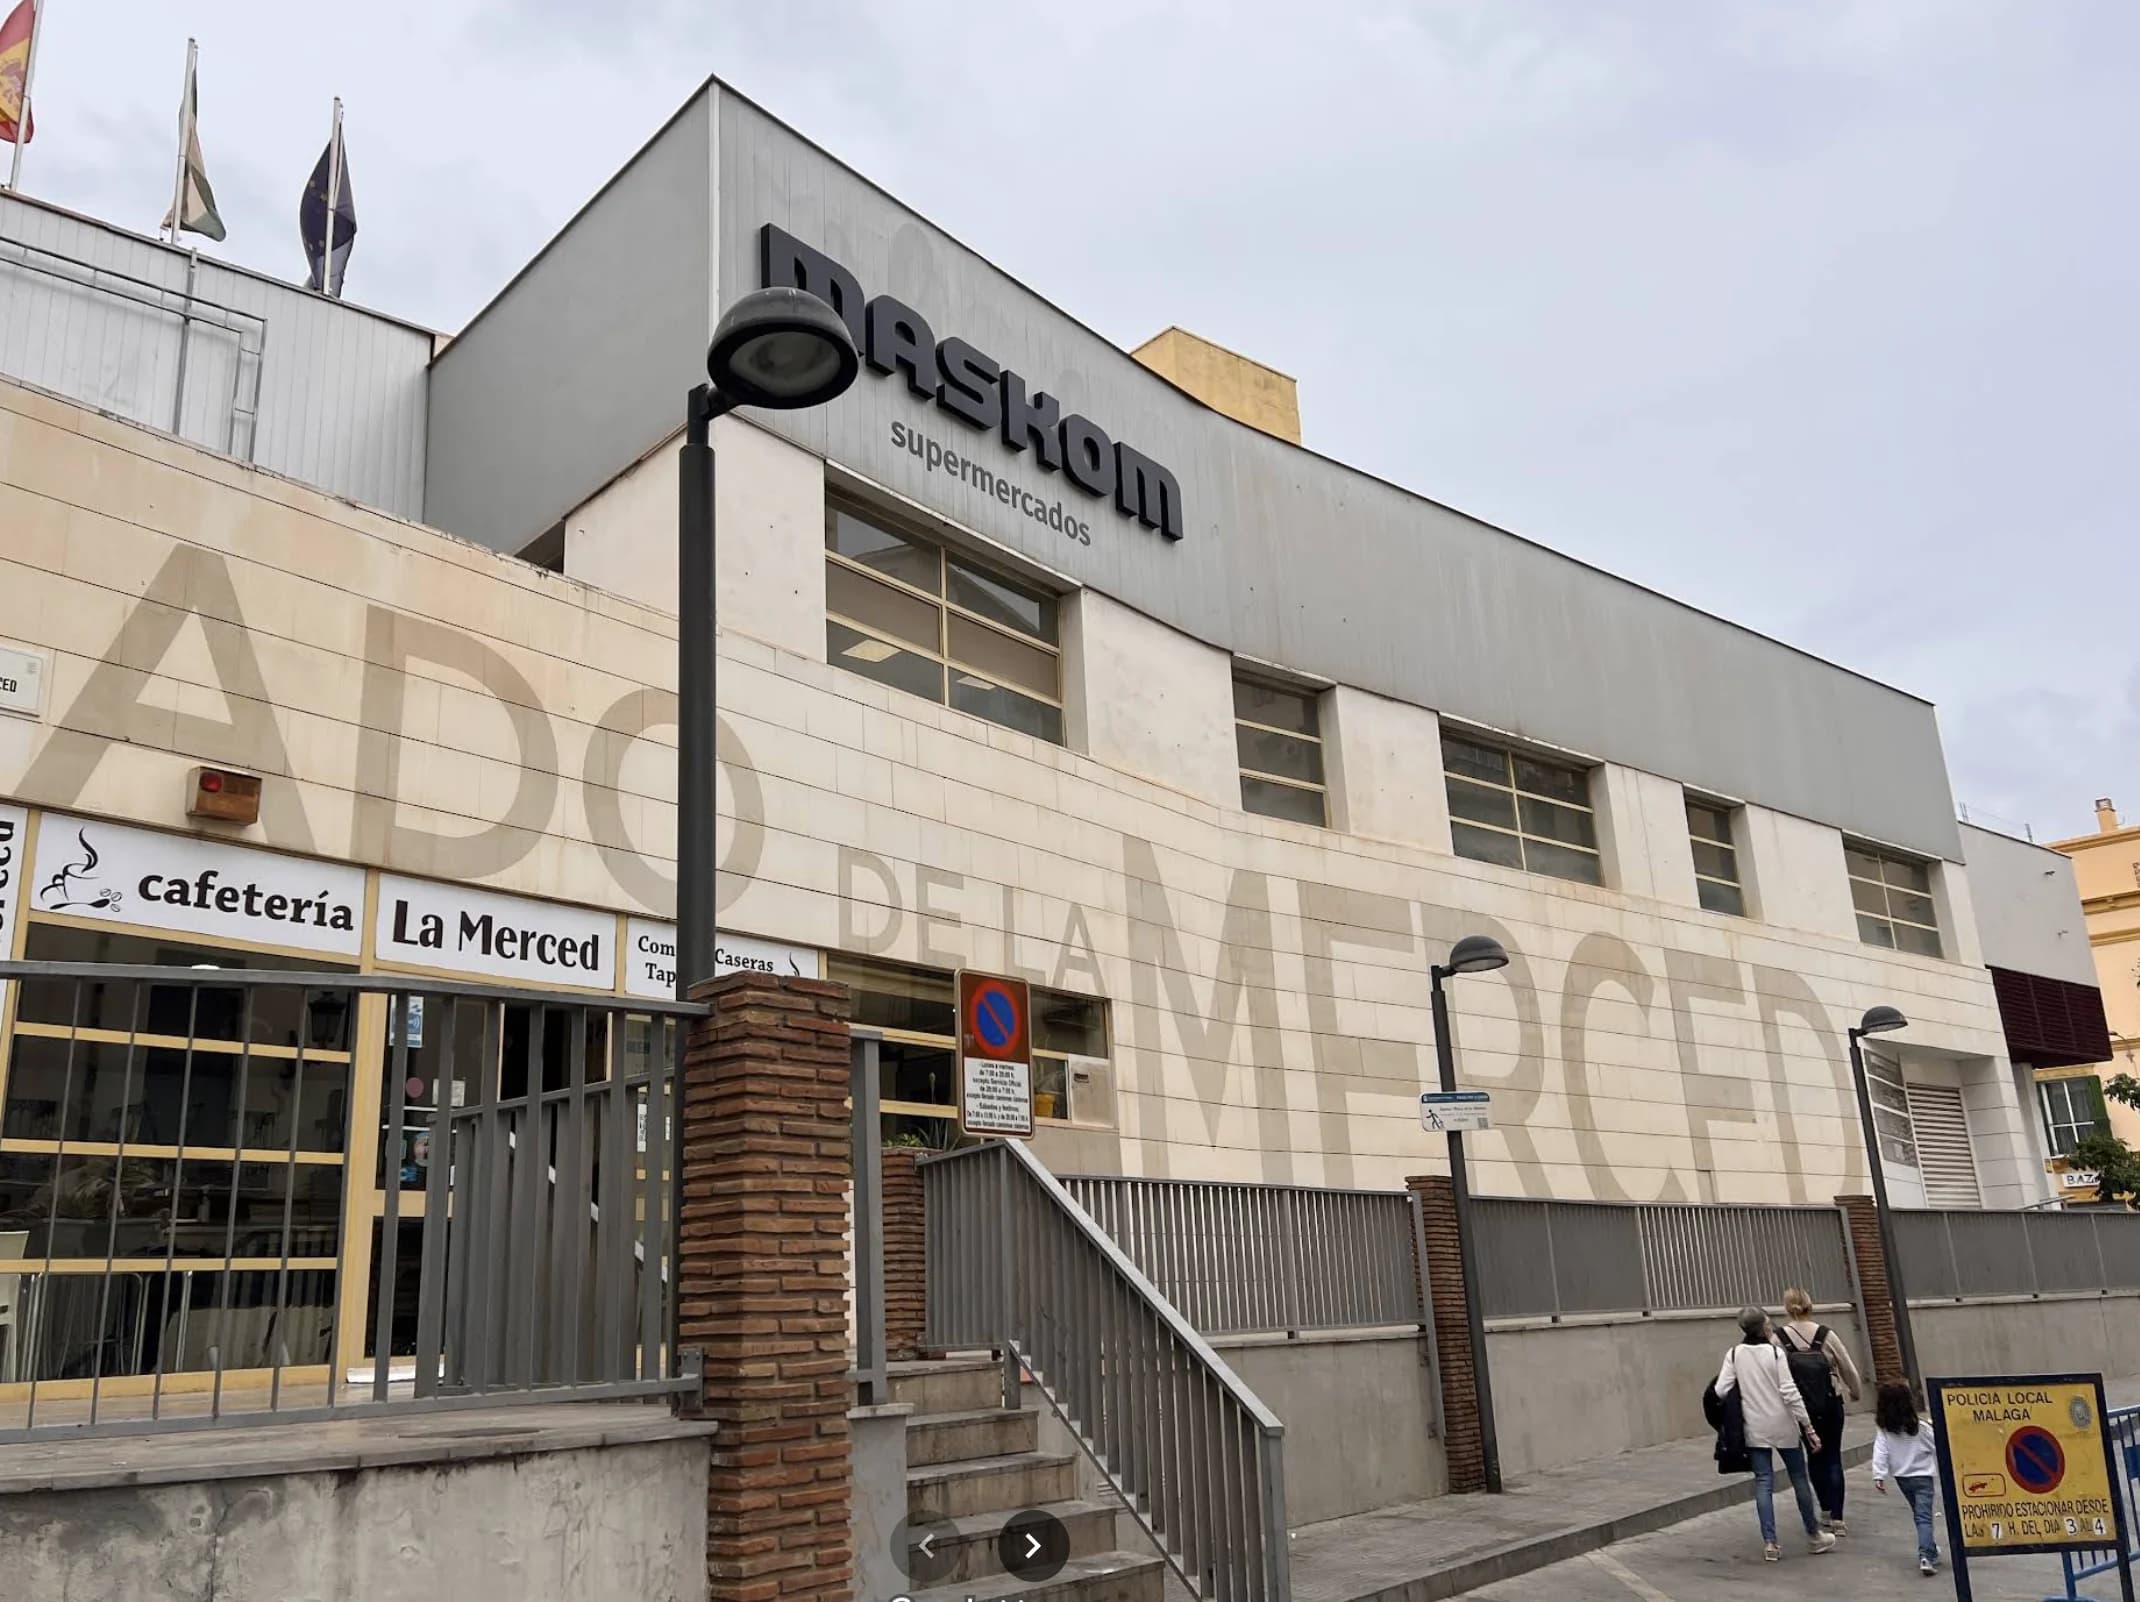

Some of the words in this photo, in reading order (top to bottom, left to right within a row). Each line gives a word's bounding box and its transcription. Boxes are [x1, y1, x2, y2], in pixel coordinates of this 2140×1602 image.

[761, 223, 1183, 542] MASKOM
[890, 420, 1092, 547] supermercados
[138, 869, 354, 931] cafetería
[392, 899, 444, 949] La
[458, 910, 599, 971] Merced
[638, 935, 676, 957] Com
[714, 948, 774, 972] Caseras
[645, 962, 677, 988] Tap
[838, 844, 967, 969] DE
[1002, 884, 1106, 999] LA
[1122, 834, 1864, 1204] MERCED
[2067, 1174, 2099, 1185] BAZ
[1947, 1392, 2002, 1406] POLICIA
[2007, 1391, 2053, 1405] LOCAL
[2016, 1500, 2074, 1517] ESTACIONAR
[2076, 1498, 2109, 1514] DESDE
[1992, 1522, 2001, 1539] 7
[2021, 1520, 2042, 1535] DEL
[2065, 1518, 2077, 1534] 3
[2094, 1518, 2104, 1534] 4
